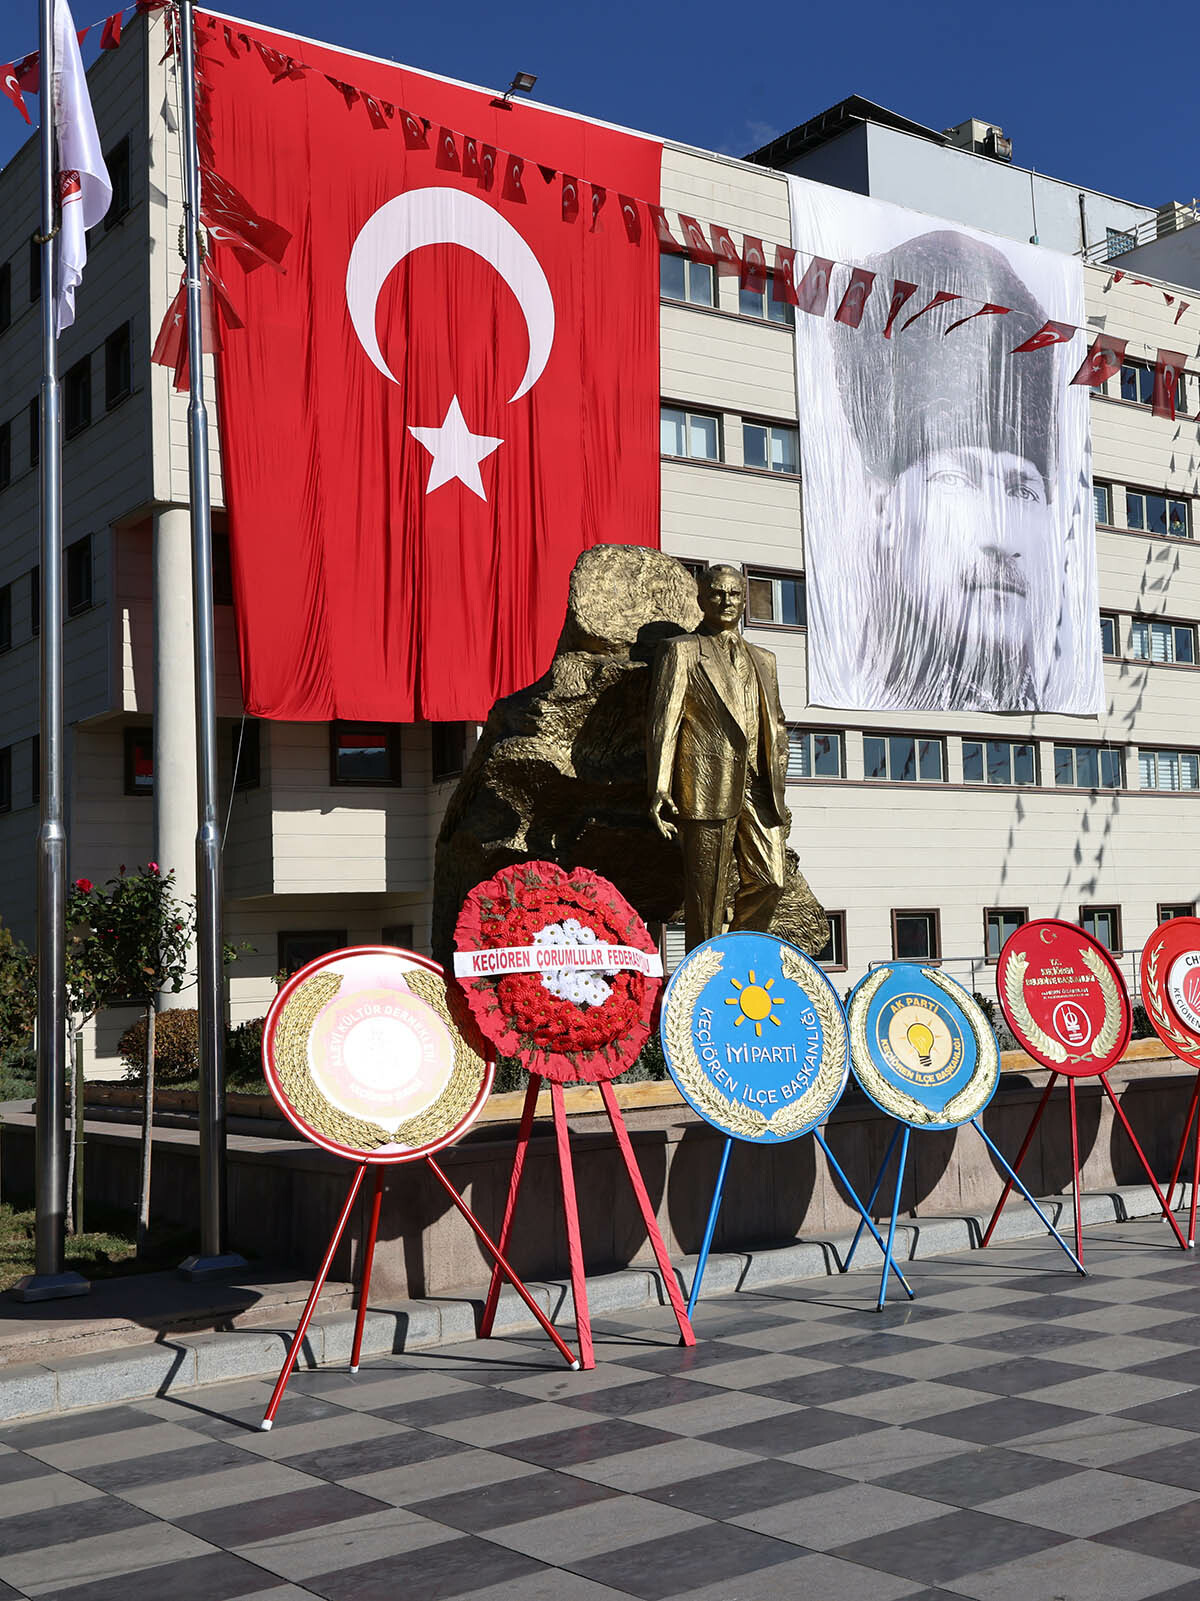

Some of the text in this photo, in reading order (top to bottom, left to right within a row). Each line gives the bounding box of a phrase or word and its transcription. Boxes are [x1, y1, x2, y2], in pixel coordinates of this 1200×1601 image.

[472, 948, 531, 973] KEÇİÖREN
[536, 949, 604, 968] ÇORUMLULAR
[890, 997, 939, 1014] AK PARTİ
[694, 1007, 819, 1108] KEÇİÖREN İLÇE BAŞKANLIĞI
[726, 1043, 797, 1063] İYİ PARTİ
[880, 1037, 962, 1085] KEÇİÖREN İLÇE BAŞKANLIĞI
